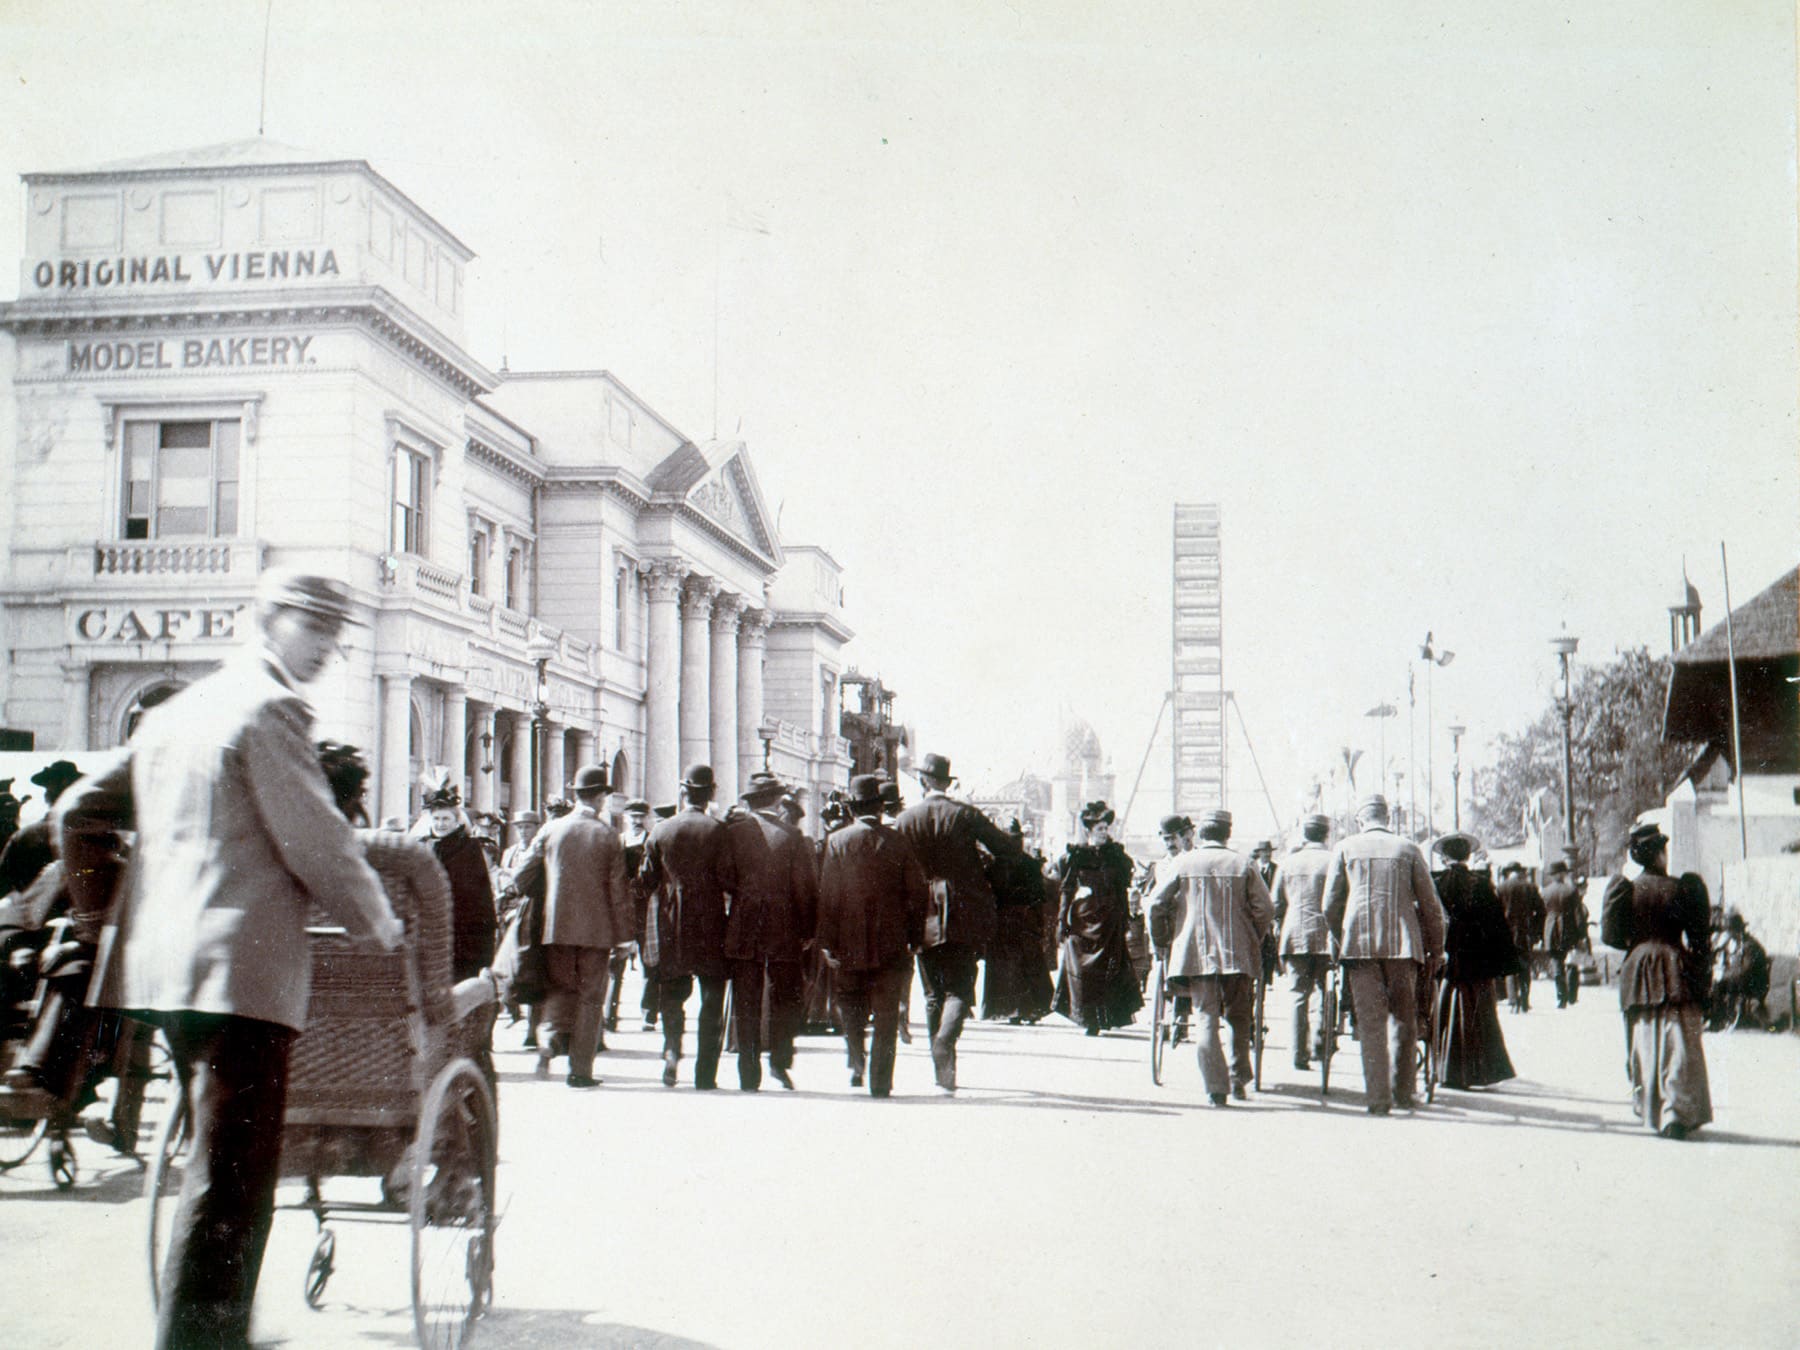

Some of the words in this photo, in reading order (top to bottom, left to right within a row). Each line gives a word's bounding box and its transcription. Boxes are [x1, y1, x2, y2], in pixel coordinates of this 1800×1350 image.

[34, 254, 192, 288] ORIGINAL
[204, 249, 341, 281] VIENNA
[67, 340, 173, 373] MODEL
